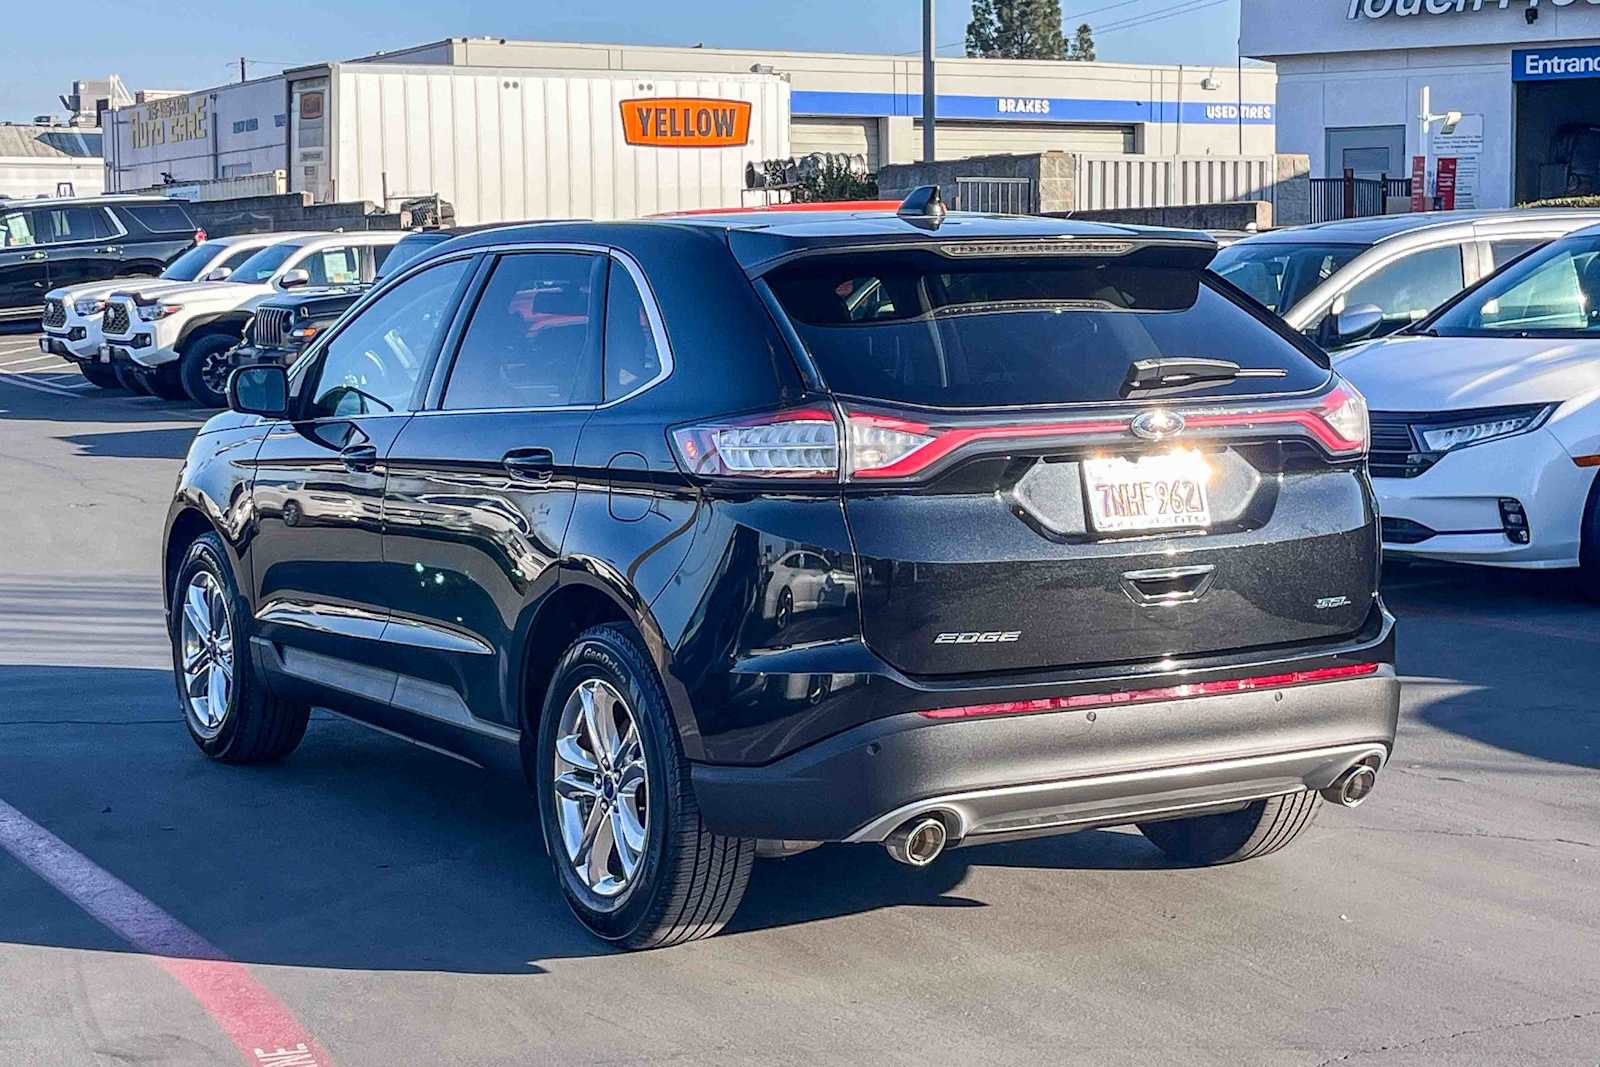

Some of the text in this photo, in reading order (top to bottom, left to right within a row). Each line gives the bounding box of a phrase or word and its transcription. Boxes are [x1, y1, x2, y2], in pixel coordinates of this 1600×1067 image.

[998, 98, 1050, 114] BRAKES
[1206, 104, 1273, 119] USED TIRES
[128, 111, 166, 149] AUTO
[637, 107, 736, 137] YELLOW
[1095, 480, 1204, 518] 7NHF962
[934, 630, 1022, 644] EDGE
